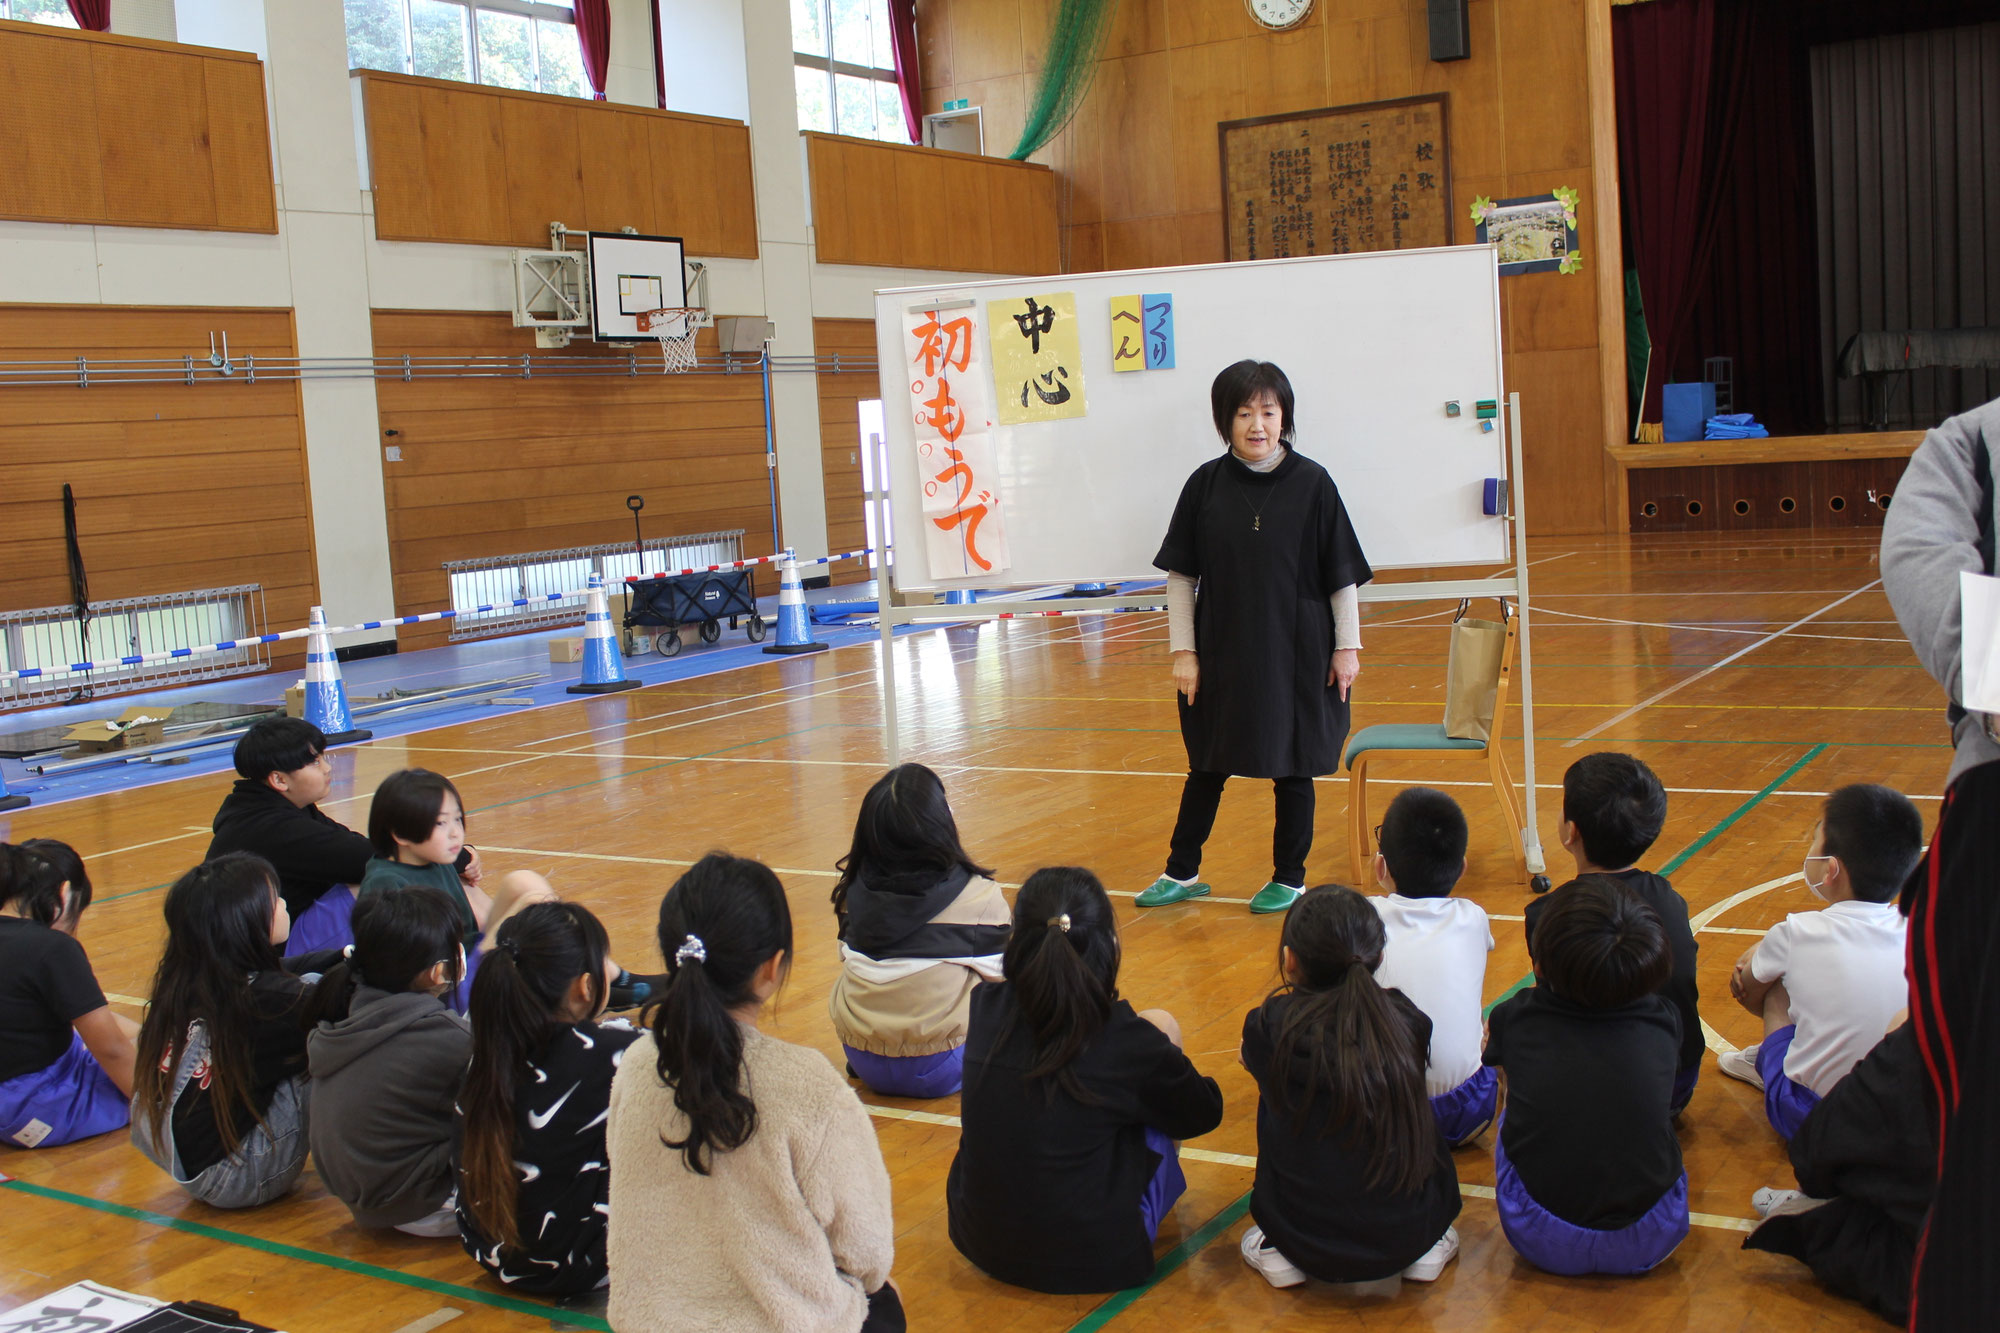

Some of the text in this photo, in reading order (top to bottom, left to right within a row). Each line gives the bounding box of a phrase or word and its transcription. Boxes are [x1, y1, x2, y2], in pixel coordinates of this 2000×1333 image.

[1415, 142, 1435, 191] 校歌
[1013, 296, 1072, 408] 中心
[1112, 309, 1141, 360] へん
[1145, 302, 1171, 366] つくり
[911, 310, 993, 572] 初もうで
